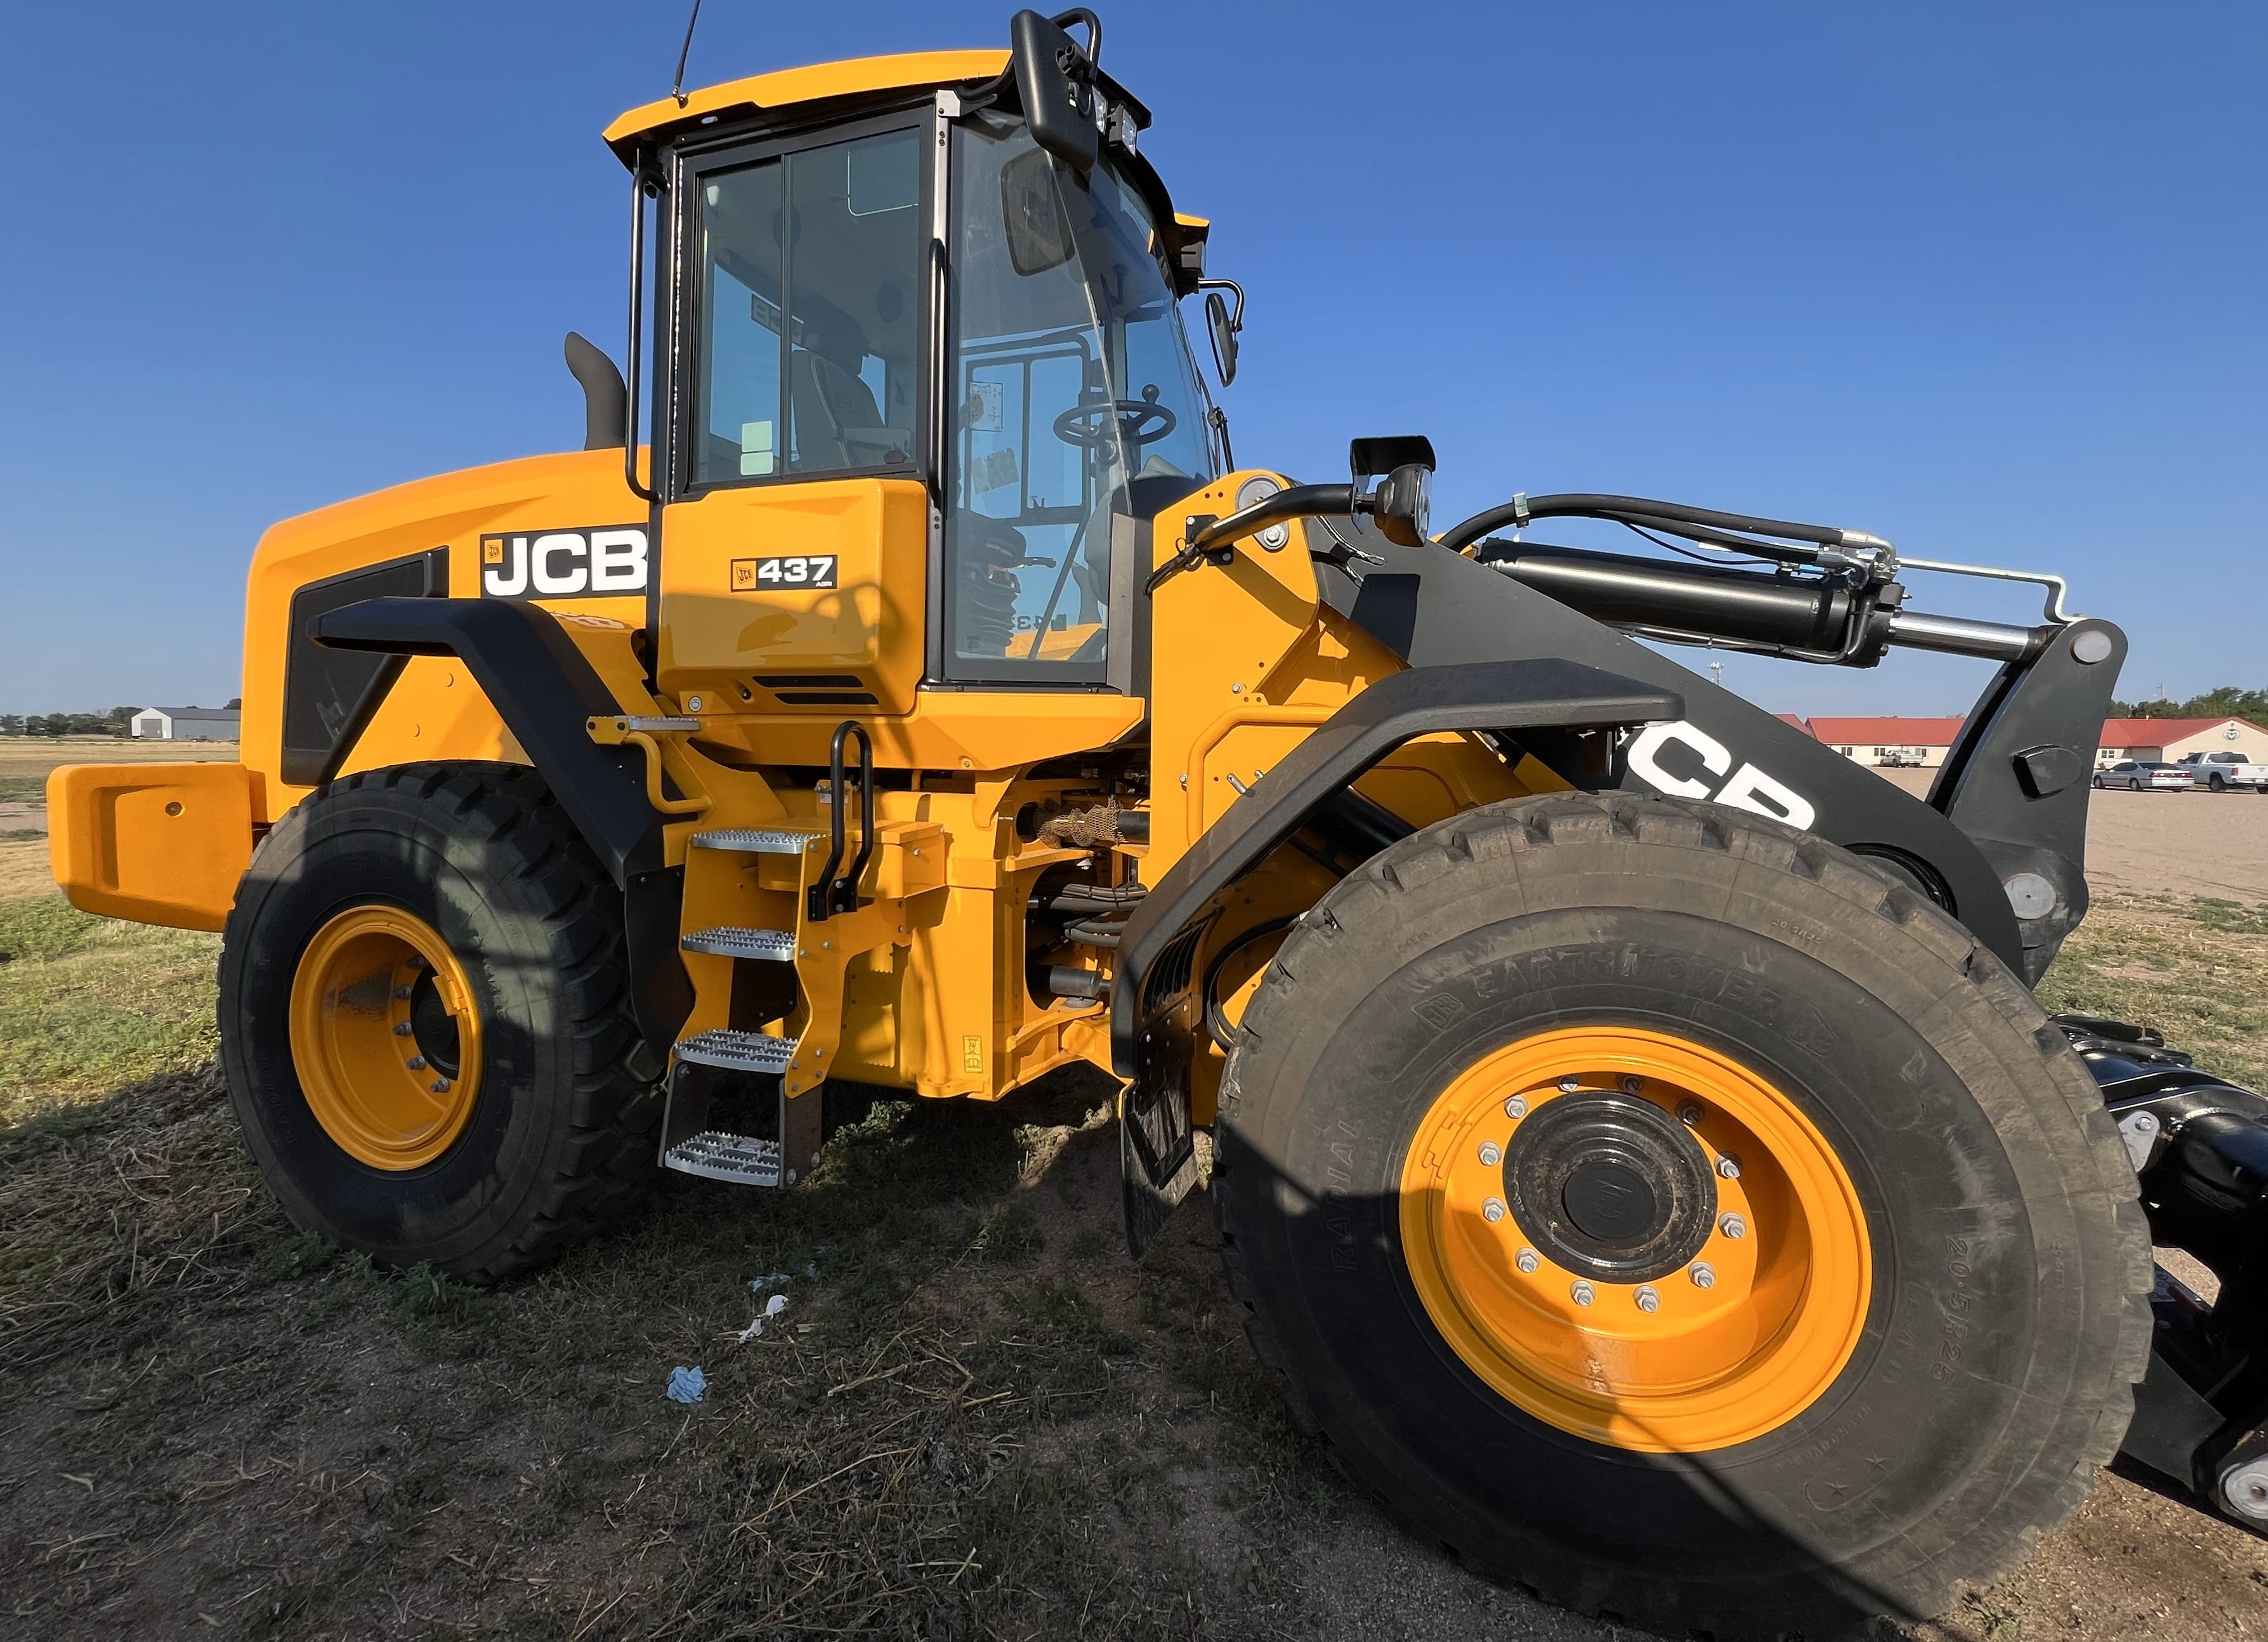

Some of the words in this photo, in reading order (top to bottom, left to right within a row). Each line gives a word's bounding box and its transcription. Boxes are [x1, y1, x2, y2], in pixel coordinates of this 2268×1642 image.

[484, 529, 648, 596] JCB
[758, 556, 833, 583] 437
[1325, 1119, 1364, 1270] RADIAL
